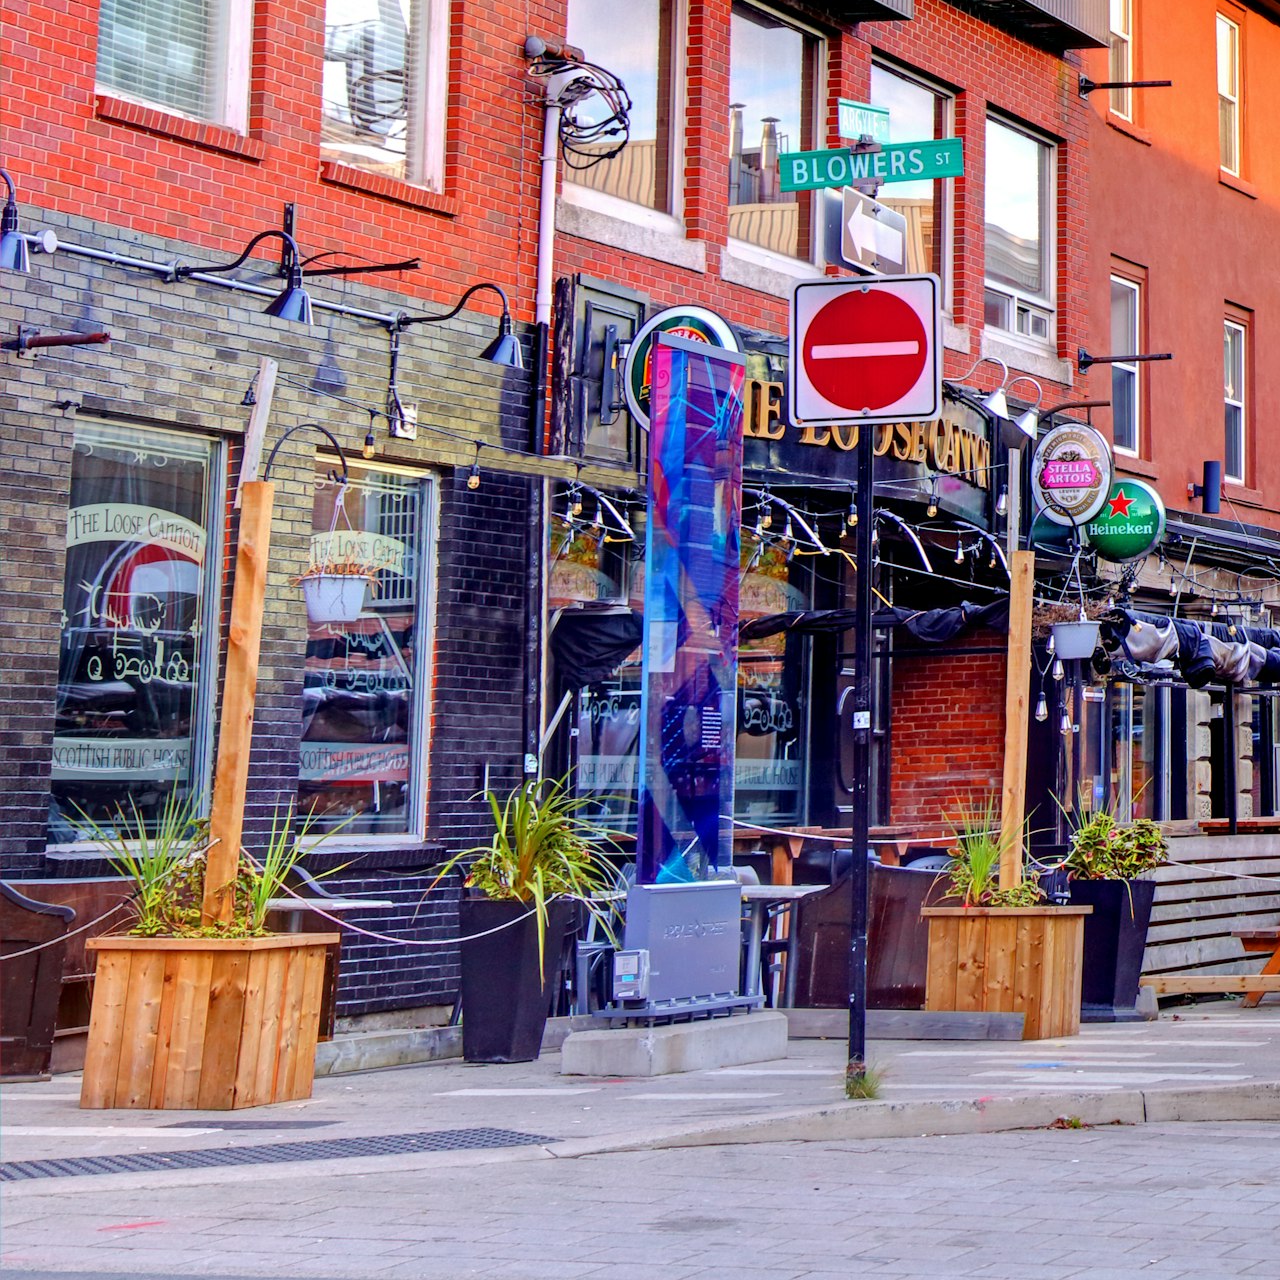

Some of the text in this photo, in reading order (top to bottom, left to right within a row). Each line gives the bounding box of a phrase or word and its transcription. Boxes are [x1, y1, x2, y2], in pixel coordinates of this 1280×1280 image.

[842, 106, 888, 137] ARGYLE ST
[792, 148, 951, 185] BLOWERS ST
[1048, 464, 1091, 473] STELLA
[1048, 473, 1092, 484] ARTOIS
[70, 510, 99, 540] THE
[104, 509, 144, 536] LOOSE
[1089, 522, 1153, 536] Heineken
[53, 743, 110, 769] SCOTTISH
[113, 748, 151, 771] PUBLIC
